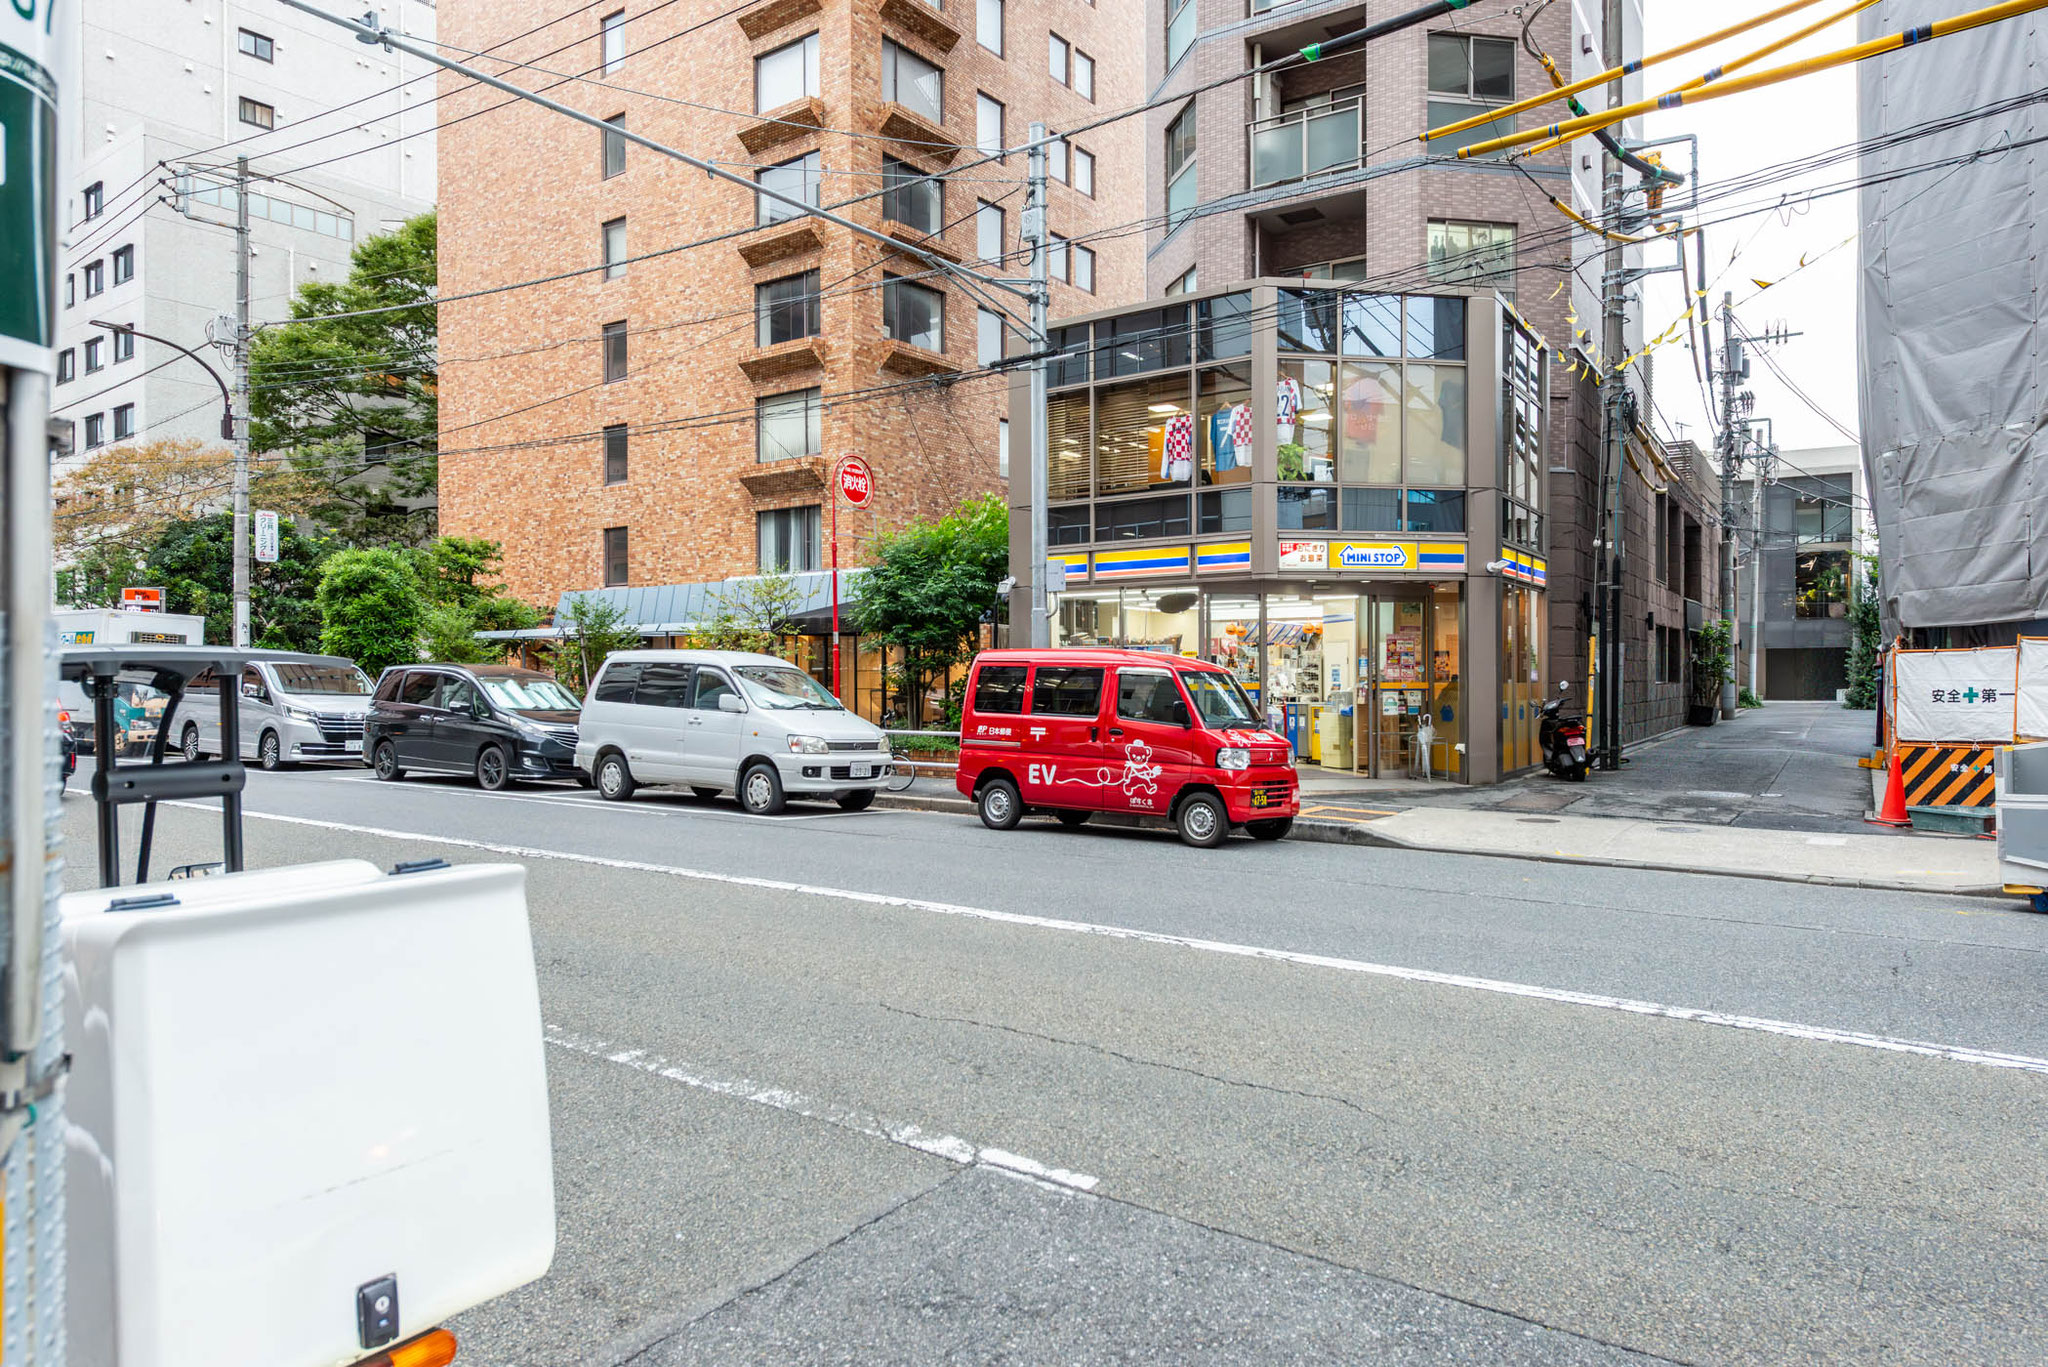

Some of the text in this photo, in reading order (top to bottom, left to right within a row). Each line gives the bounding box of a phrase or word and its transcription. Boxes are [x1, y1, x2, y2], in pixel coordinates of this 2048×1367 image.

[843, 474, 867, 493] 消火栓
[1297, 544, 1326, 553] おにぎり
[1347, 553, 1401, 563] MINI STOP
[1029, 764, 1057, 785] EV
